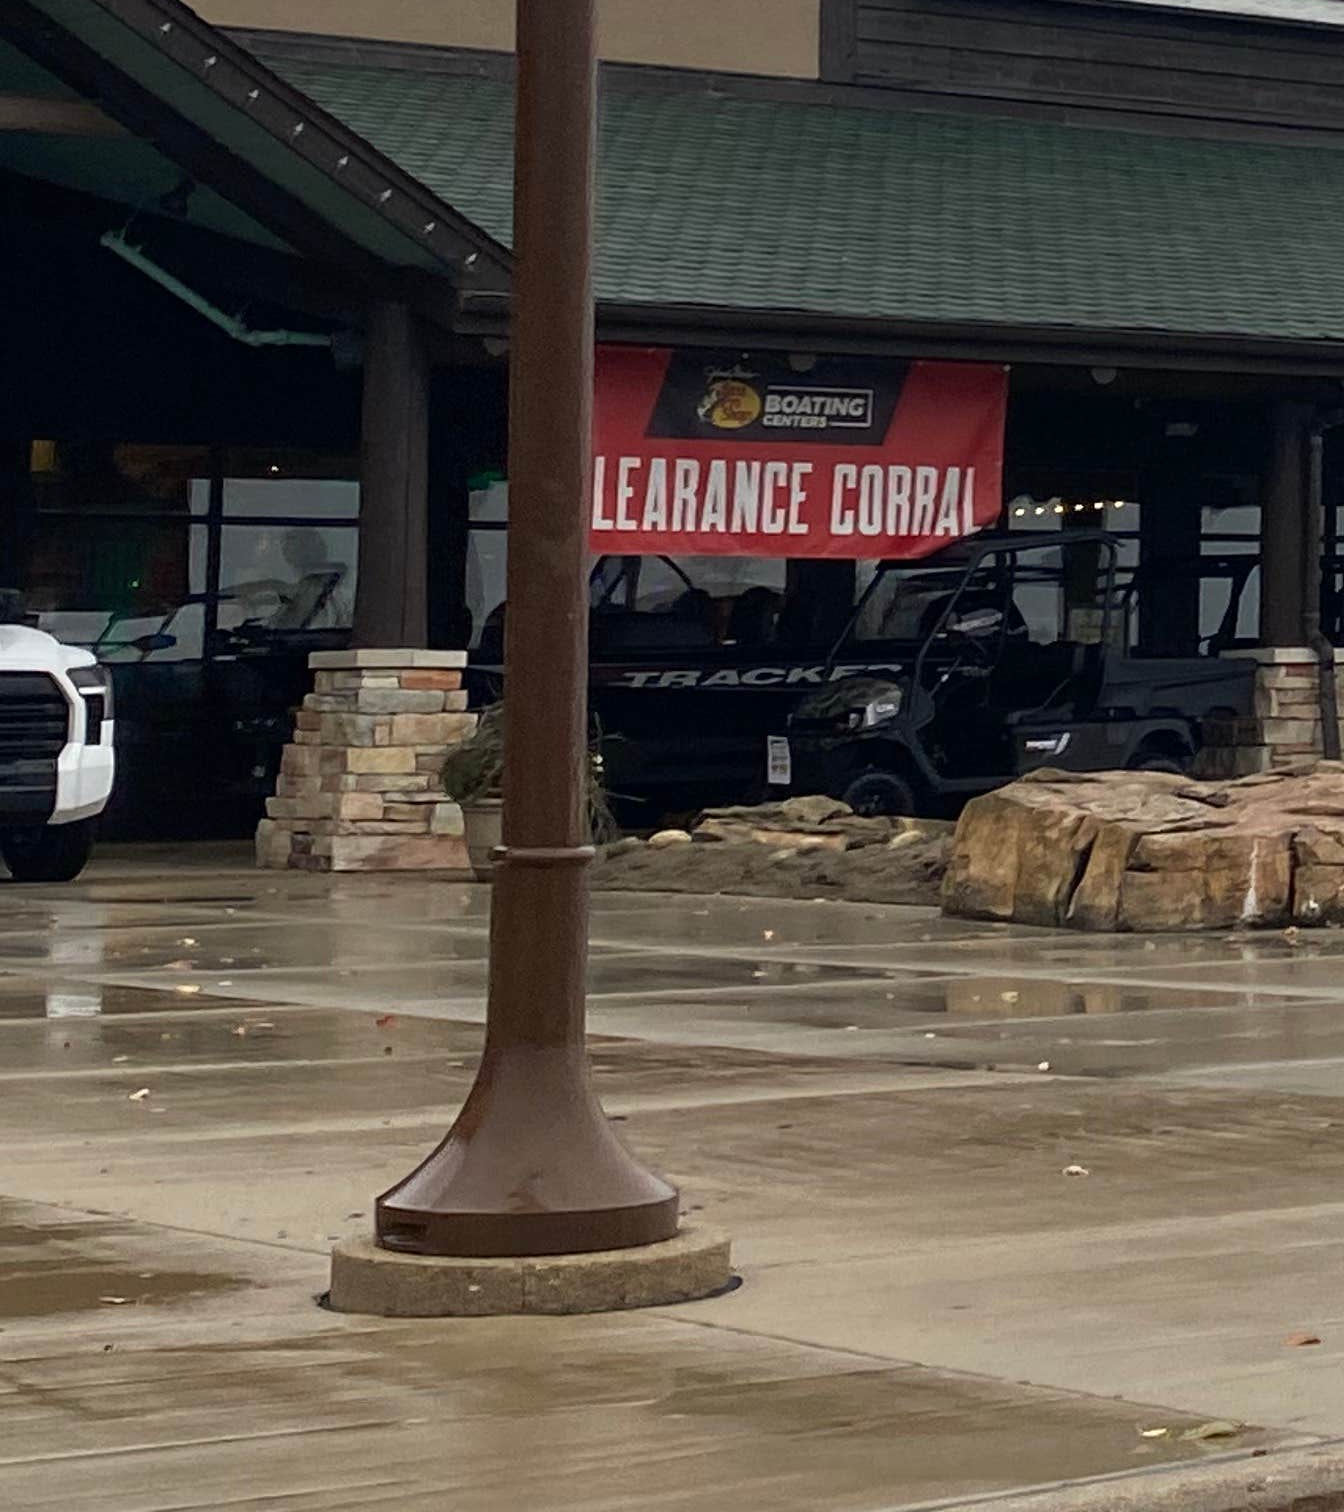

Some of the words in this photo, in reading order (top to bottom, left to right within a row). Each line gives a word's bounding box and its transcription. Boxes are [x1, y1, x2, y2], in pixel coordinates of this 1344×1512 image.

[764, 394, 866, 417] BOATING
[762, 413, 829, 429] CENTERS
[590, 455, 813, 536] LEARANCE
[829, 462, 984, 538] CORRAL
